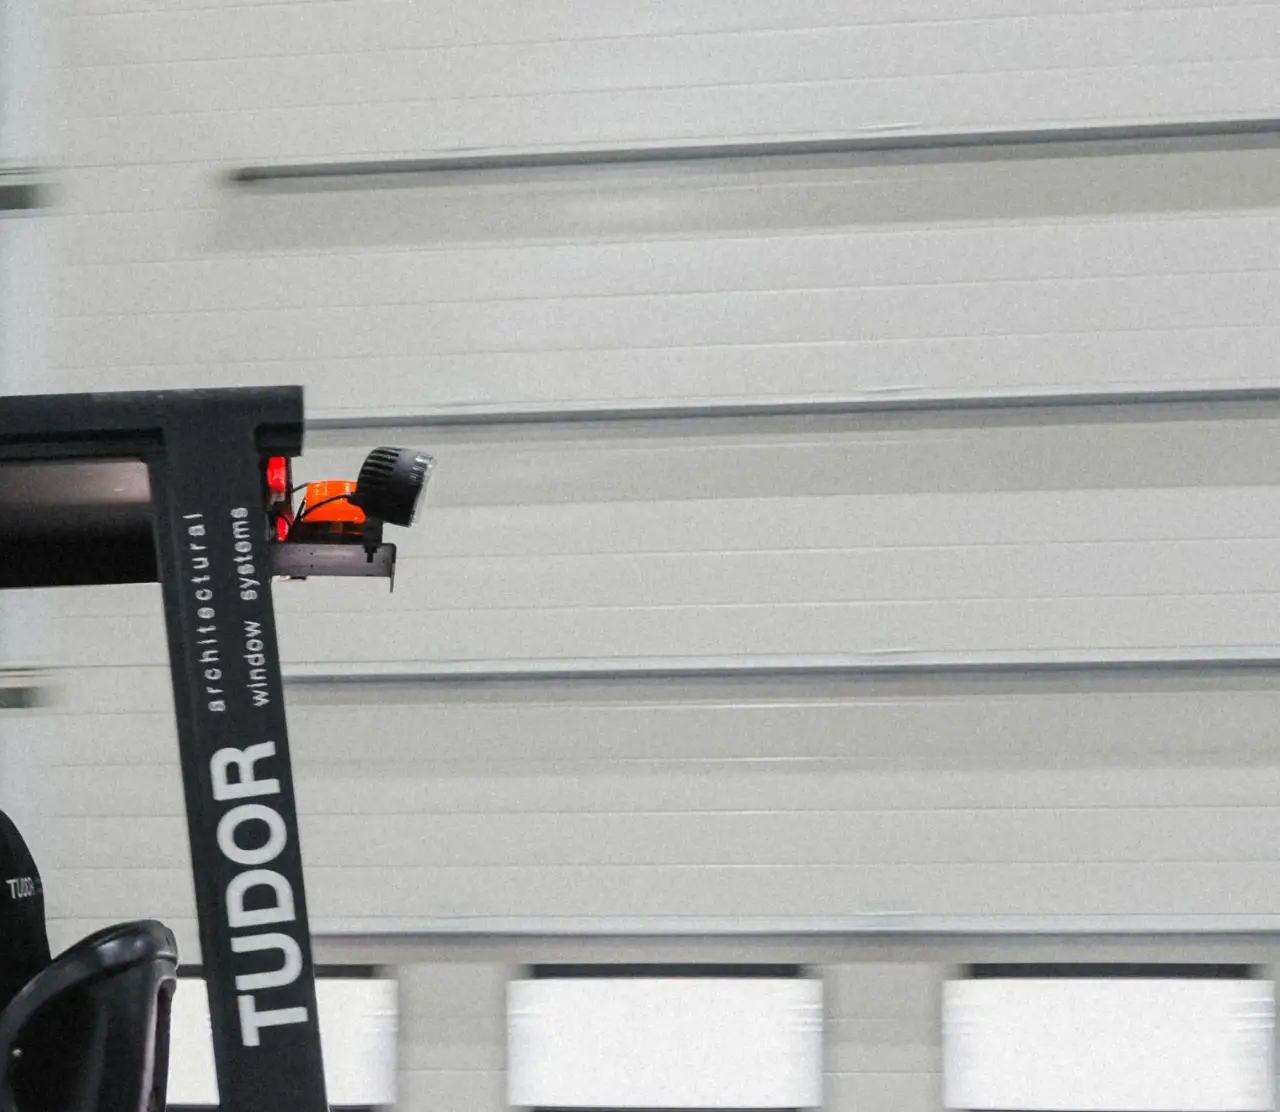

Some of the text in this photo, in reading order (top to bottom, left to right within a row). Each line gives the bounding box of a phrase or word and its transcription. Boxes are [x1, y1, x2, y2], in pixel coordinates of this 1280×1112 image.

[182, 512, 226, 712] architectural
[230, 506, 271, 707] window systems
[209, 739, 310, 1048] TUDOR
